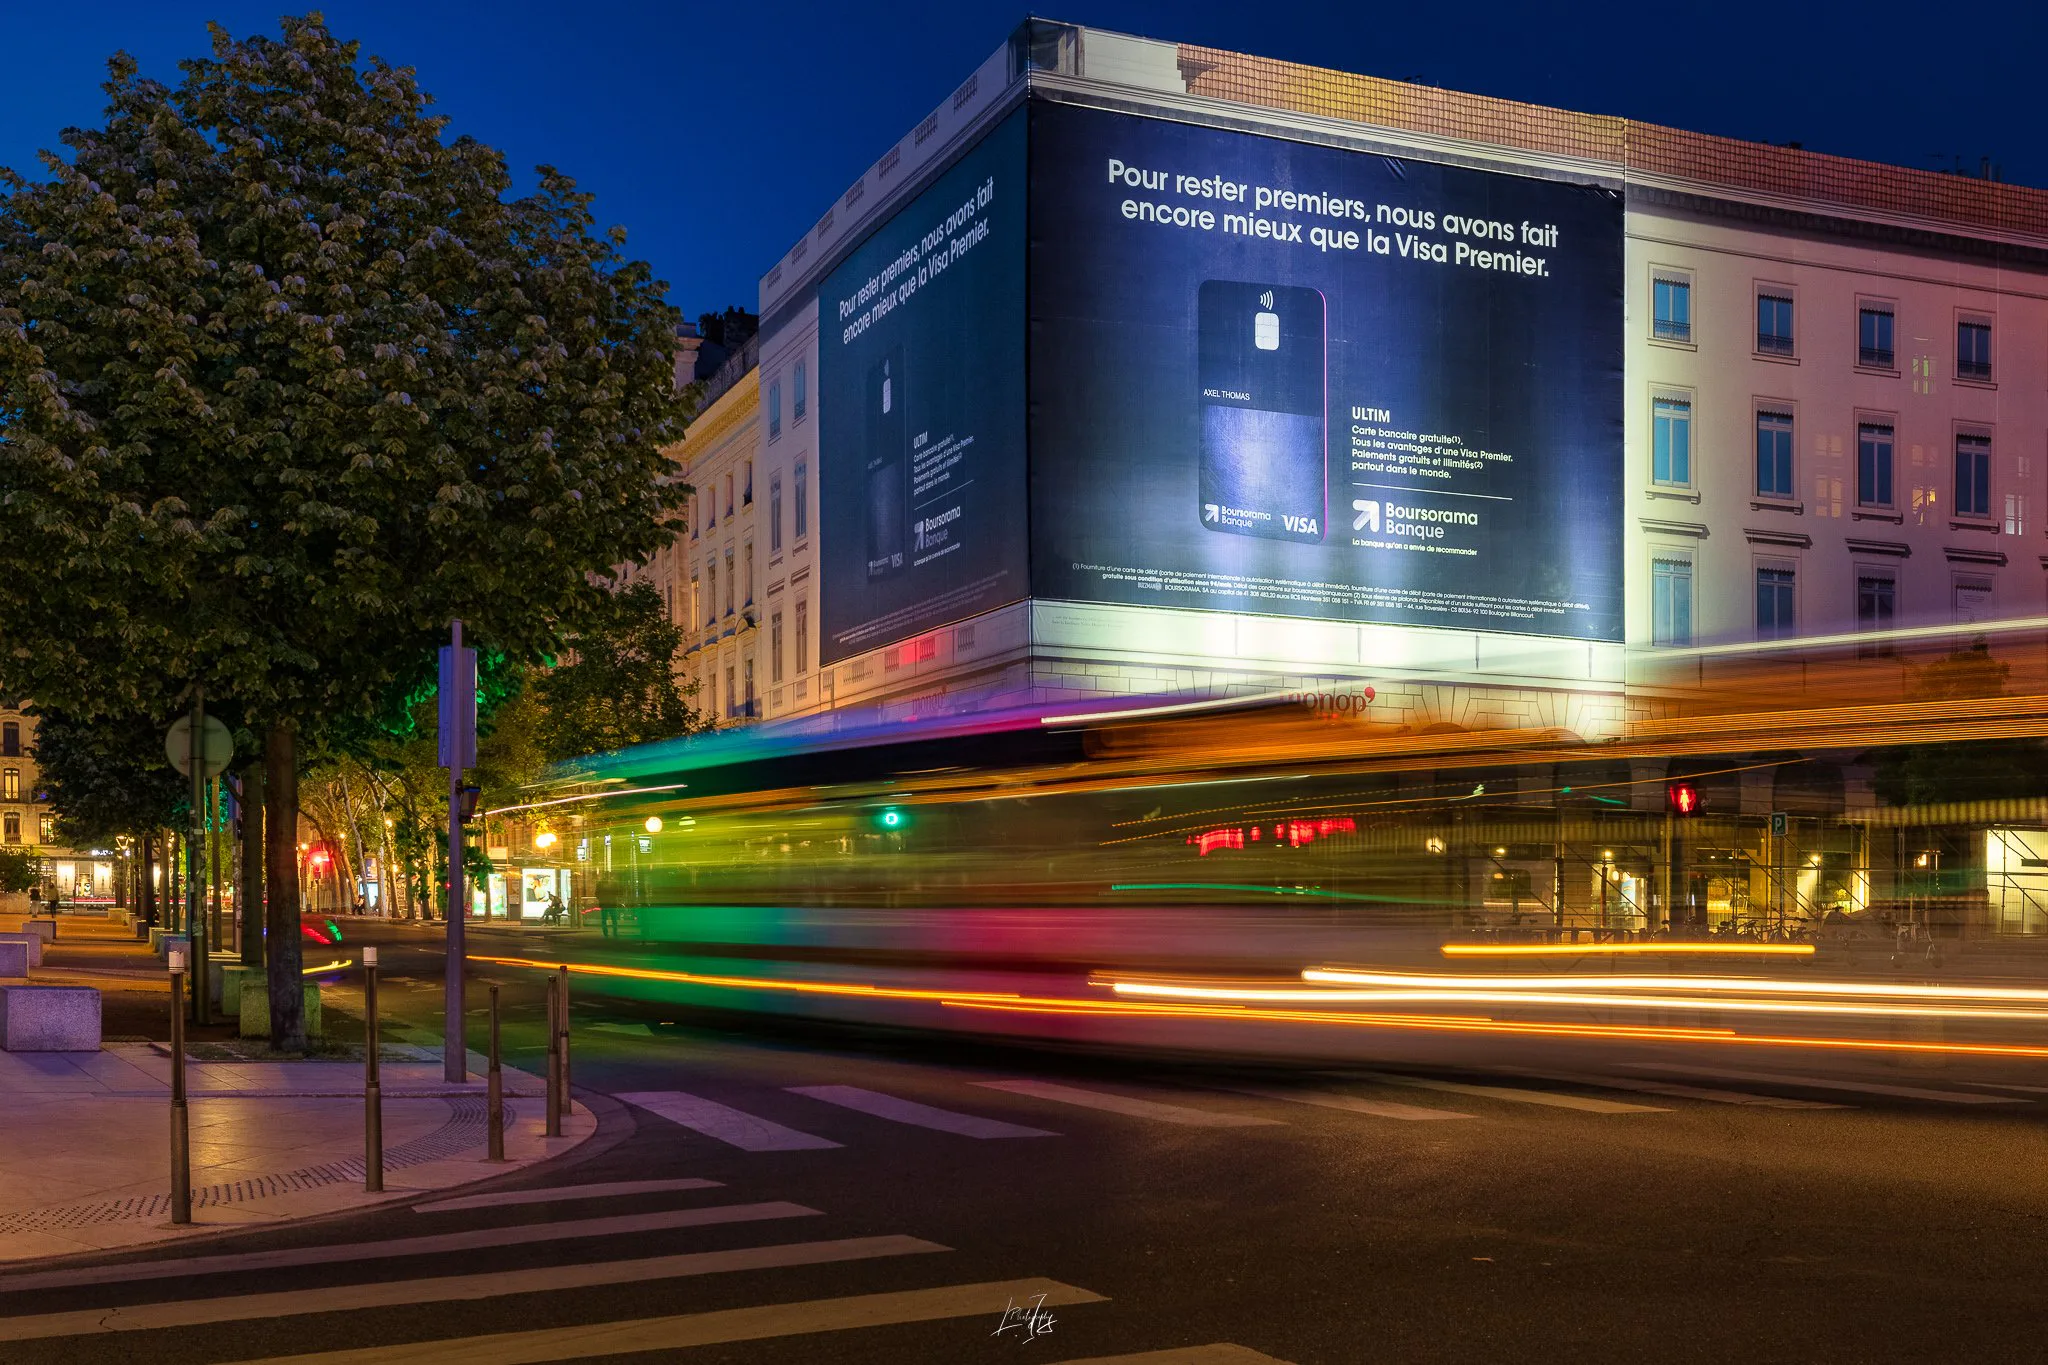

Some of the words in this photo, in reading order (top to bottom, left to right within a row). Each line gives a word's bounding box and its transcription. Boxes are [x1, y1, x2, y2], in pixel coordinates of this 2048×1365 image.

[1108, 158, 1168, 191] Pour
[1176, 174, 1248, 202] rester
[1256, 186, 1371, 224] premiers,
[1377, 204, 1436, 231] nous
[1442, 212, 1514, 242] avons
[1521, 221, 1558, 248] fait
[1121, 199, 1214, 230] encore
[1224, 213, 1302, 244] mieux
[1310, 226, 1358, 252] que
[1367, 228, 1390, 255] la
[1395, 233, 1447, 264] Visa
[1456, 242, 1550, 278] Premier.
[840, 294, 856, 322] Pour
[858, 276, 880, 304] rester
[881, 245, 920, 293] premiers,
[922, 223, 944, 256] nous
[946, 198, 975, 236] avons
[977, 176, 994, 210] fait
[843, 311, 870, 344] encore
[872, 290, 898, 323] mieux
[899, 276, 916, 305] que
[918, 266, 927, 288] la
[928, 250, 948, 279] Visa
[950, 218, 990, 263] Premier.
[1203, 389, 1220, 398] AXEL
[1221, 391, 1250, 400] THOMAS
[1352, 406, 1390, 423] ULTIM
[1352, 425, 1376, 436] Carte
[1378, 428, 1417, 440] bancaire
[1352, 437, 1371, 447] Tous
[1373, 439, 1385, 448] les
[1387, 442, 1432, 454] avantages
[1434, 446, 1458, 456] d'une
[1460, 448, 1478, 458] Visa
[1480, 450, 1513, 462] Premier.
[1352, 448, 1396, 461] Paiements
[1399, 454, 1430, 465] gratuits
[1352, 462, 1384, 471] partout
[1386, 464, 1407, 474] dans
[1409, 466, 1417, 475] le
[1420, 468, 1451, 478] monde.
[926, 506, 960, 532] Boursorama
[1222, 506, 1271, 520] Boursorama
[1222, 515, 1252, 528] Banque
[1386, 502, 1478, 525] Boursorama
[1281, 515, 1318, 534] VISA
[1386, 519, 1444, 540] Banque
[1361, 539, 1384, 549] banque
[1436, 547, 1477, 555] recommander
[1775, 817, 1782, 830] P
